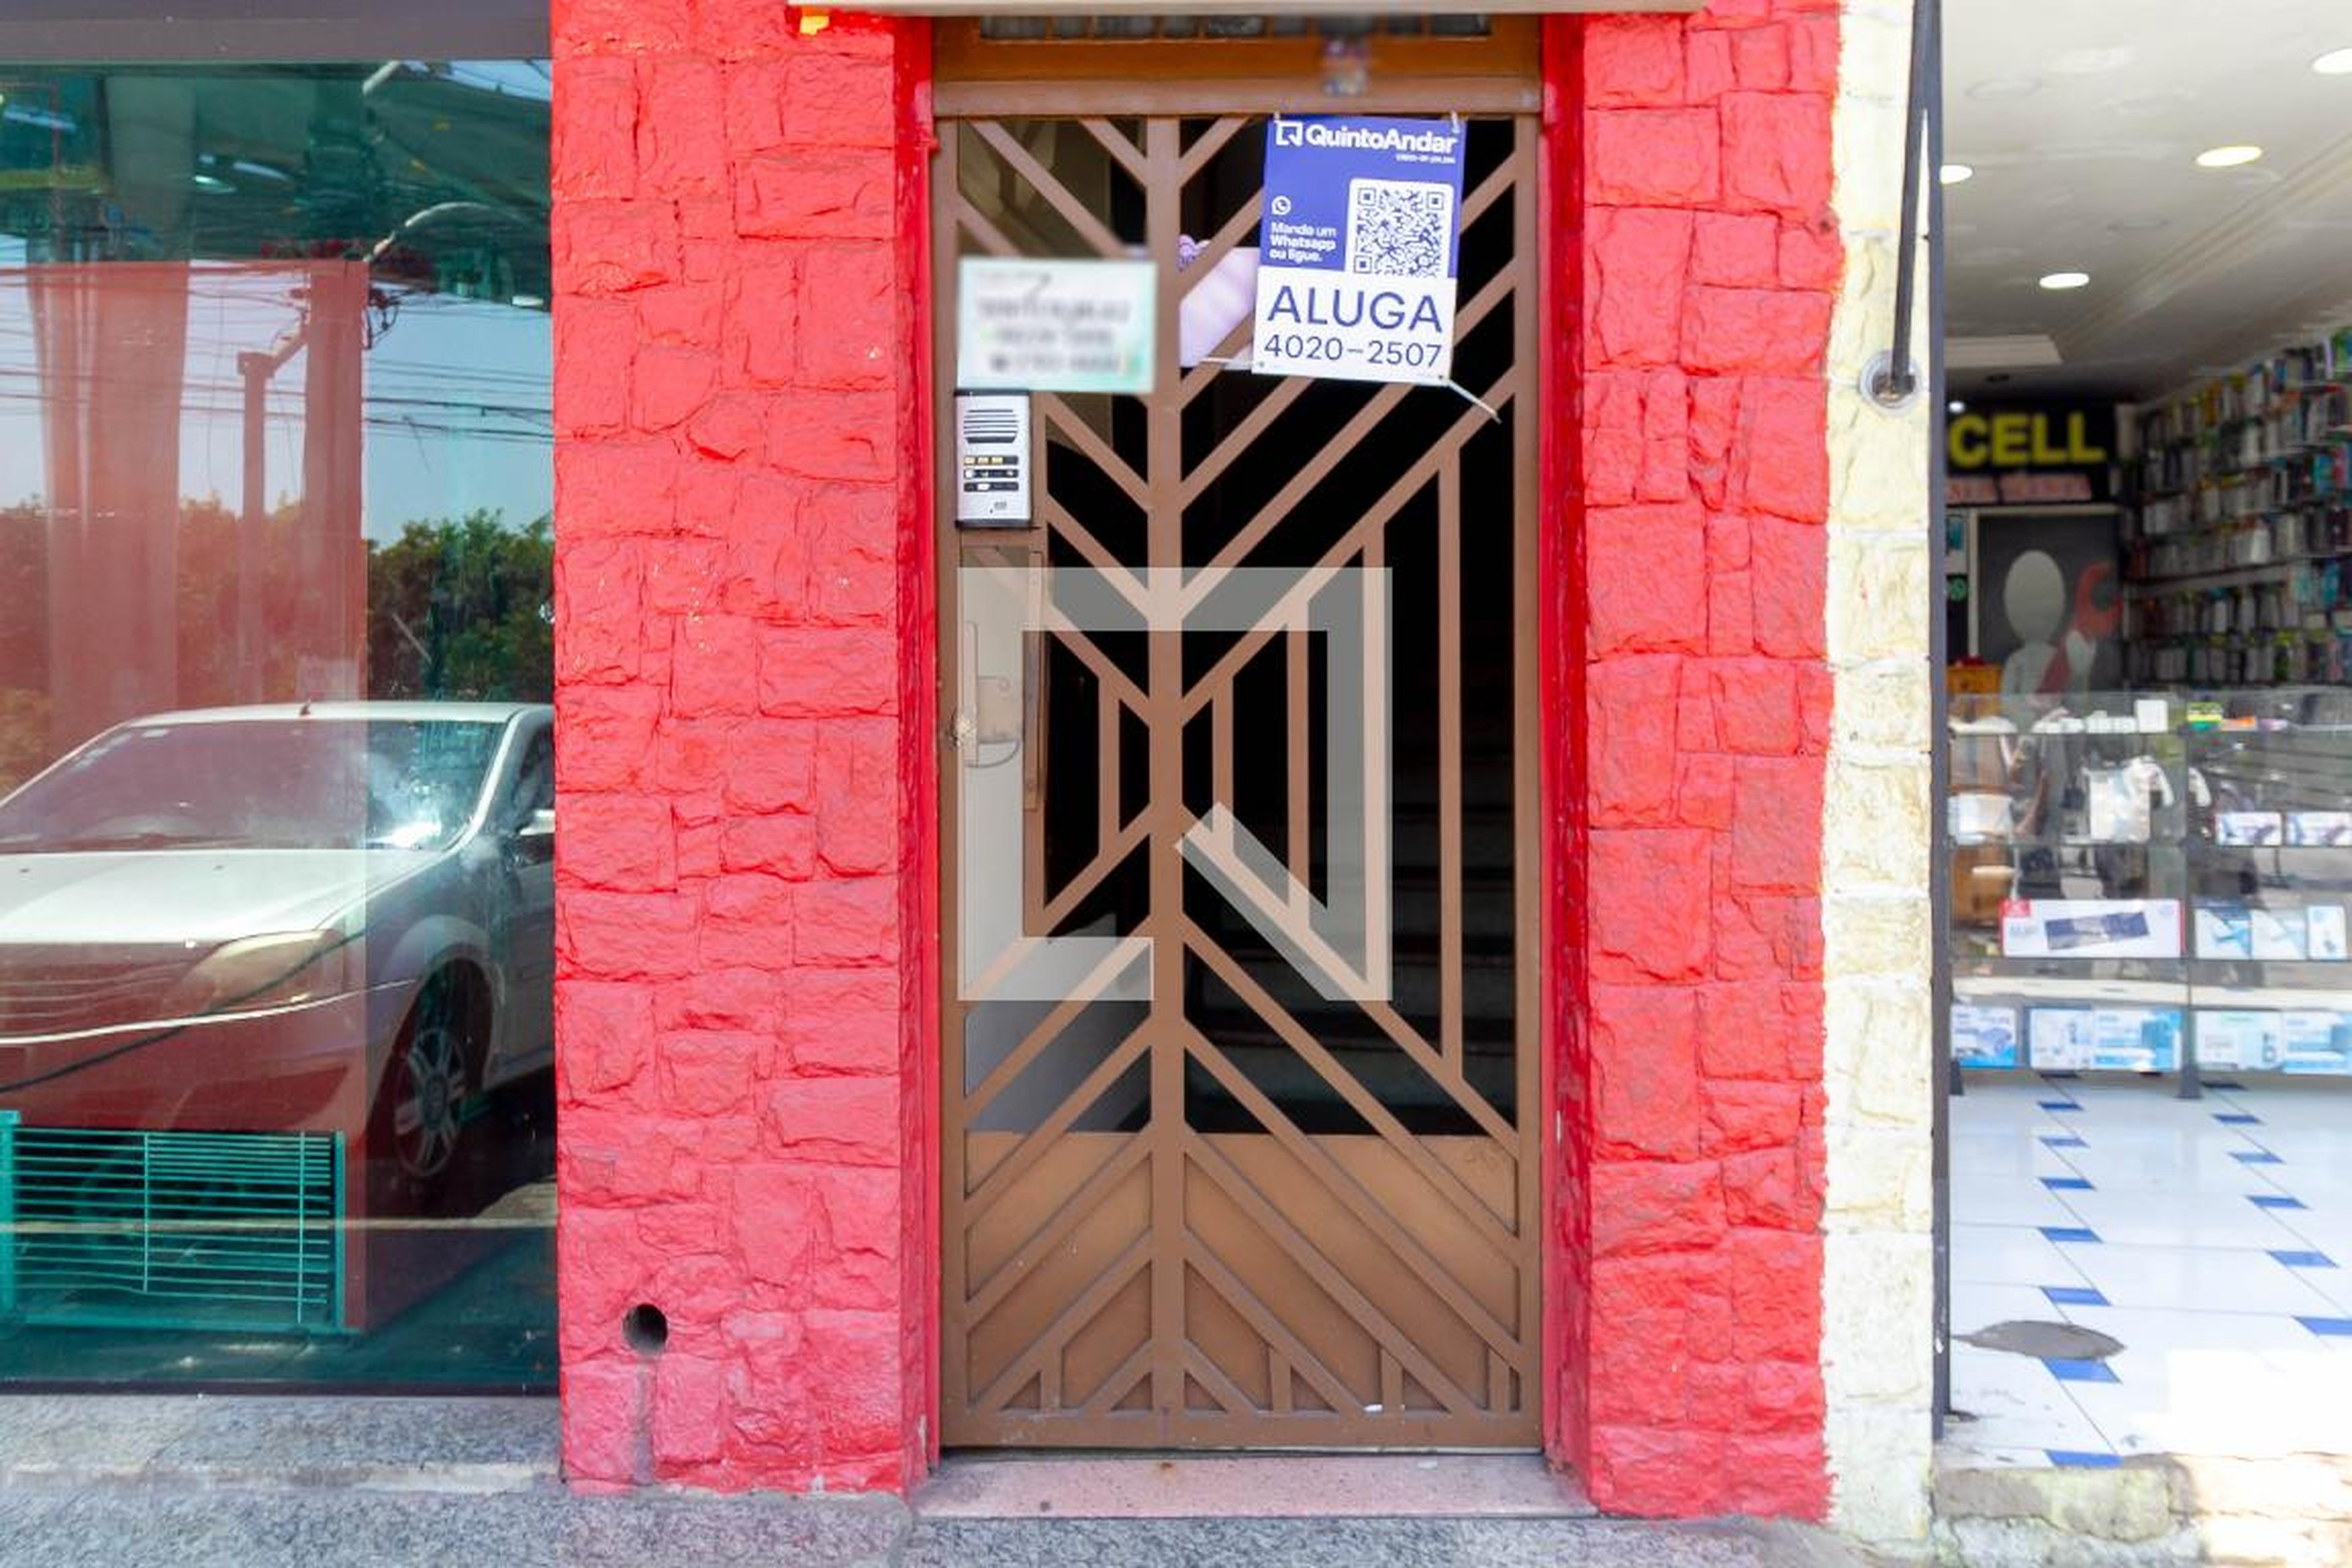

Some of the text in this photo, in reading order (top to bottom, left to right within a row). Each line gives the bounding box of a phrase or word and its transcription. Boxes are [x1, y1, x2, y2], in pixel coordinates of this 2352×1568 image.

[1306, 124, 1458, 154] QuintoAndar
[1267, 285, 1442, 333] ALUGA
[1264, 334, 1442, 367] 4020-2507
[1949, 413, 2105, 468] CELL
